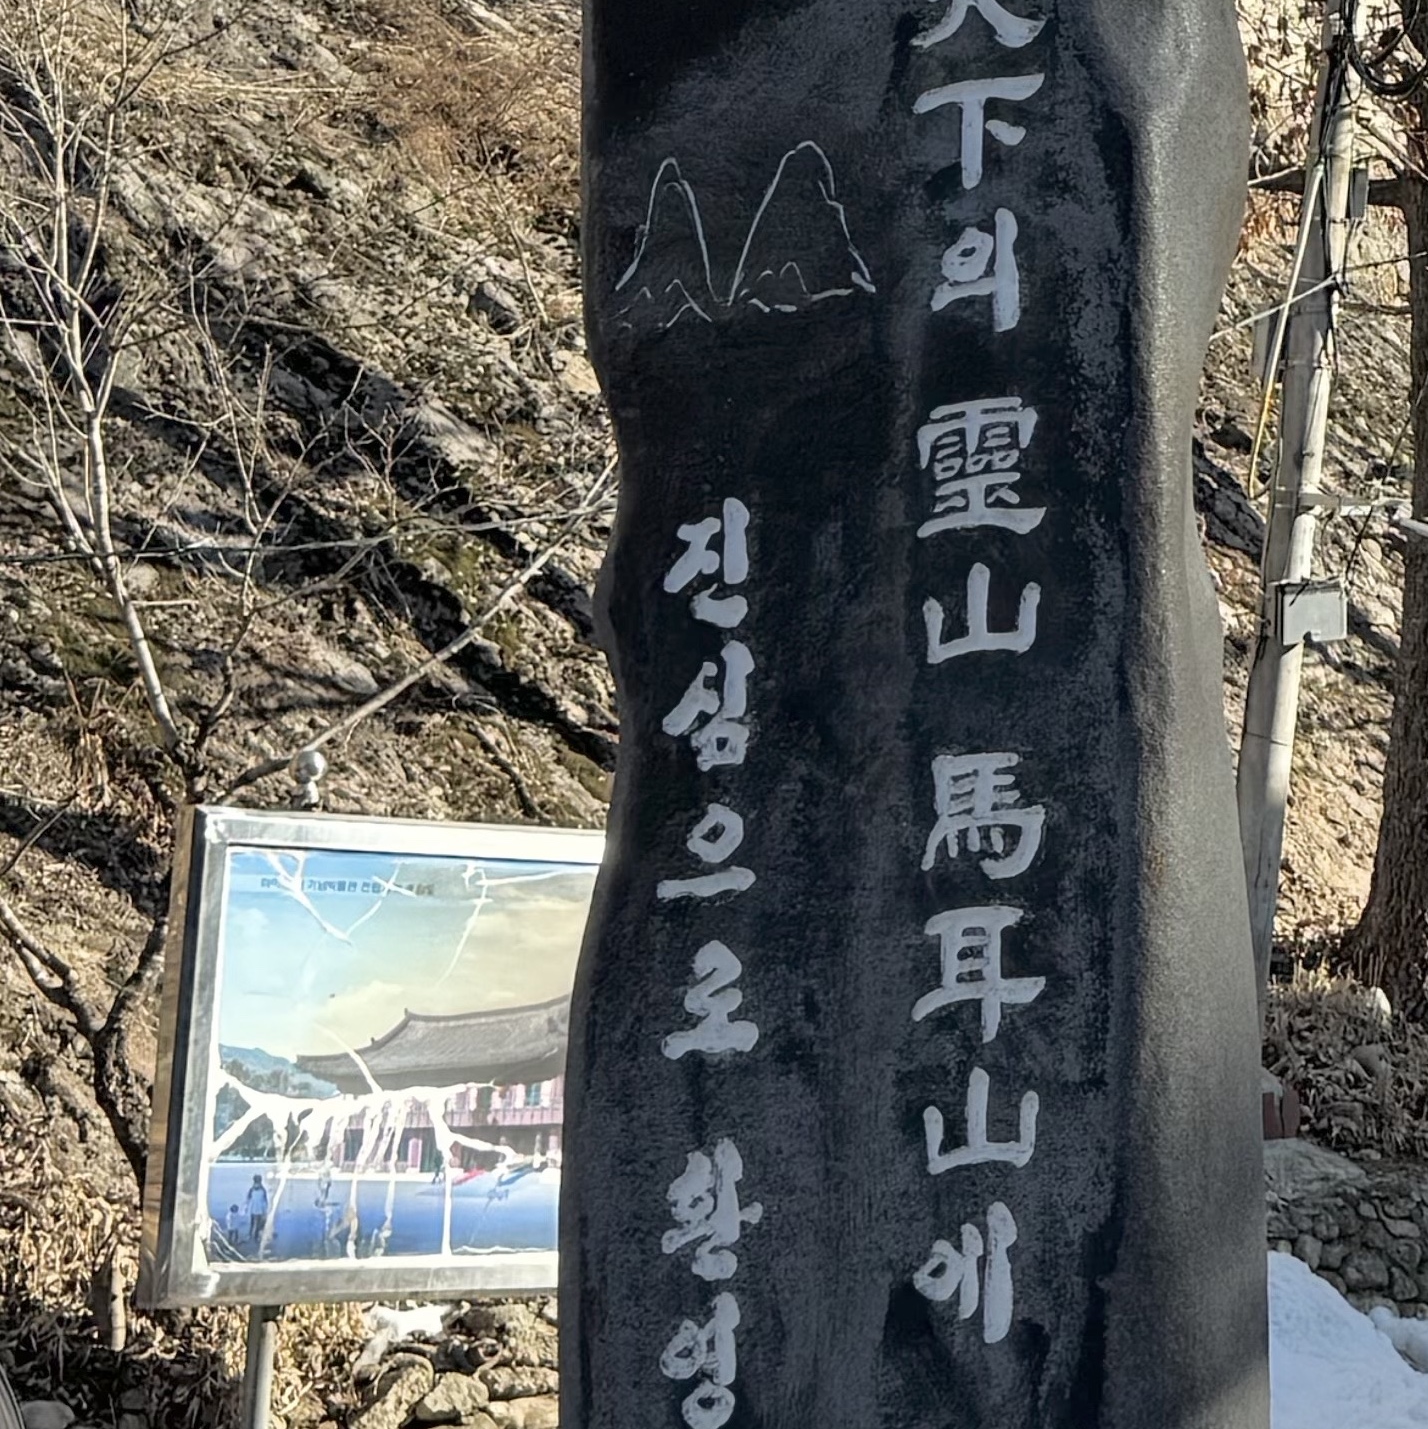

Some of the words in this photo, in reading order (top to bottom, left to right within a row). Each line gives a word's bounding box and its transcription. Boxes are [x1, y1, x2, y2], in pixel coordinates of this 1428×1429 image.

[657, 497, 760, 1061] 진심으로
[917, 397, 1046, 664] 靈山
[913, 752, 1046, 1344] 馬耳山에
